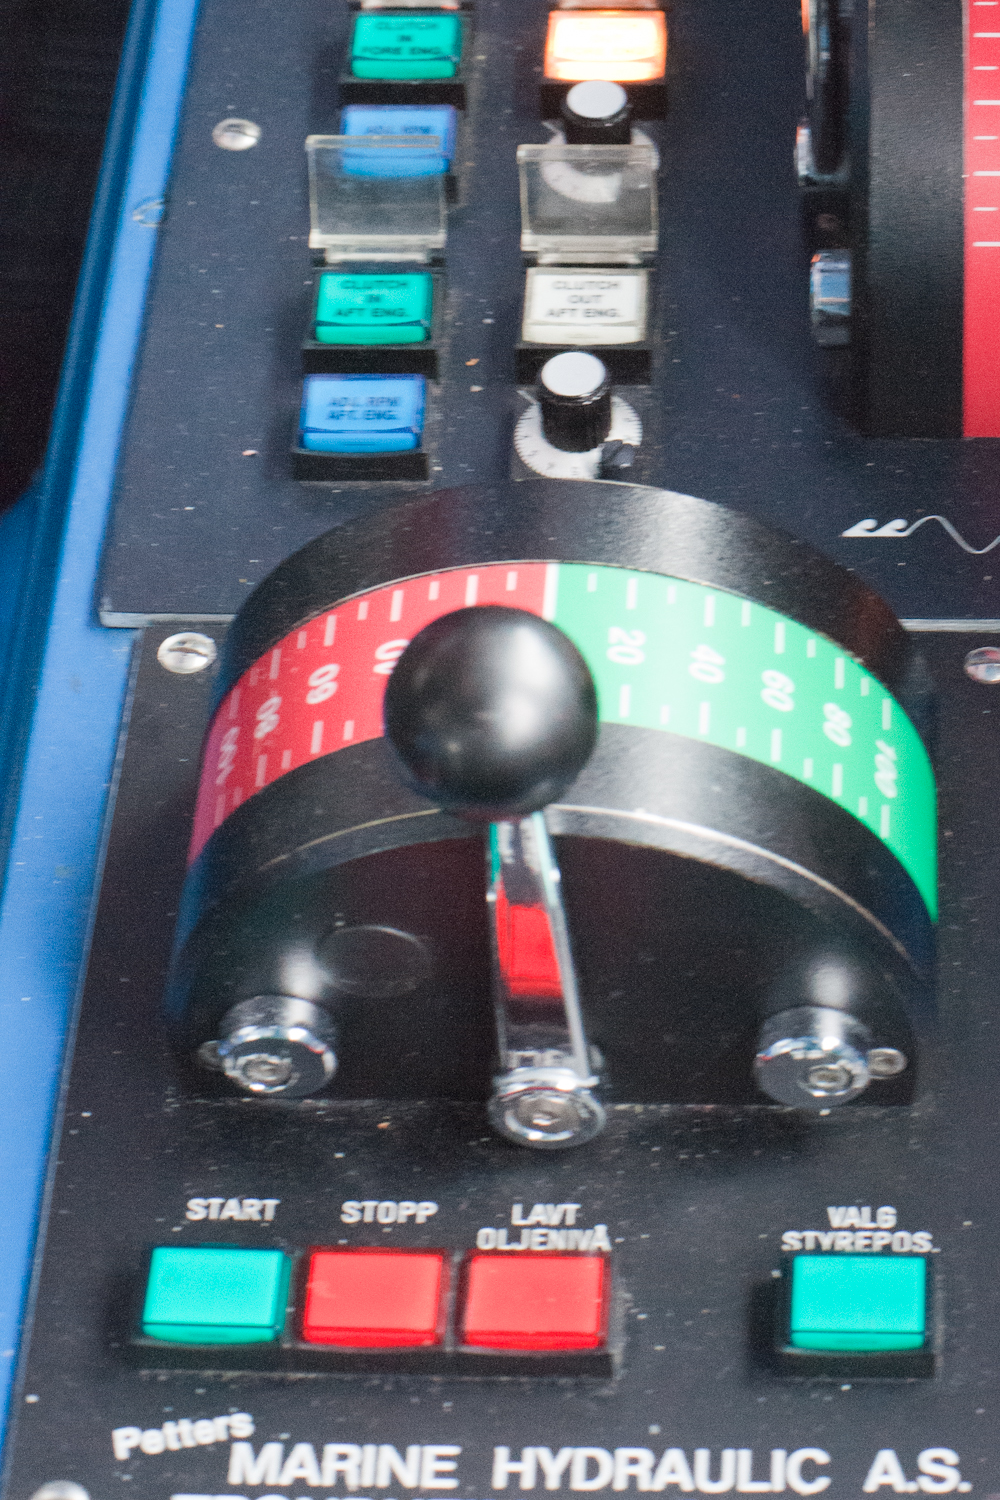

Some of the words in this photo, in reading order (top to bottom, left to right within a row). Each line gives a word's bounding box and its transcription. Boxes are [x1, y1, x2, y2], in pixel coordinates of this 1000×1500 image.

[551, 279, 622, 291] CLUTCH
[545, 307, 580, 318] AFT
[567, 294, 604, 305] OUT
[606, 626, 647, 665] 20
[688, 643, 726, 684] 40
[760, 669, 795, 712] 60
[822, 702, 853, 748] 80
[874, 739, 898, 799] 100
[185, 1197, 281, 1221] START
[341, 1200, 438, 1224] STOPP
[511, 1203, 581, 1227] LAVT
[827, 1205, 898, 1229] VALG
[476, 1224, 612, 1252] OLJENIVÅ
[781, 1230, 942, 1254] STYREPOS.
[112, 1412, 255, 1460] Petters
[227, 1441, 462, 1490] MARINE
[492, 1445, 832, 1495] HYDRAULIC
[862, 1447, 973, 1494] A.S.
